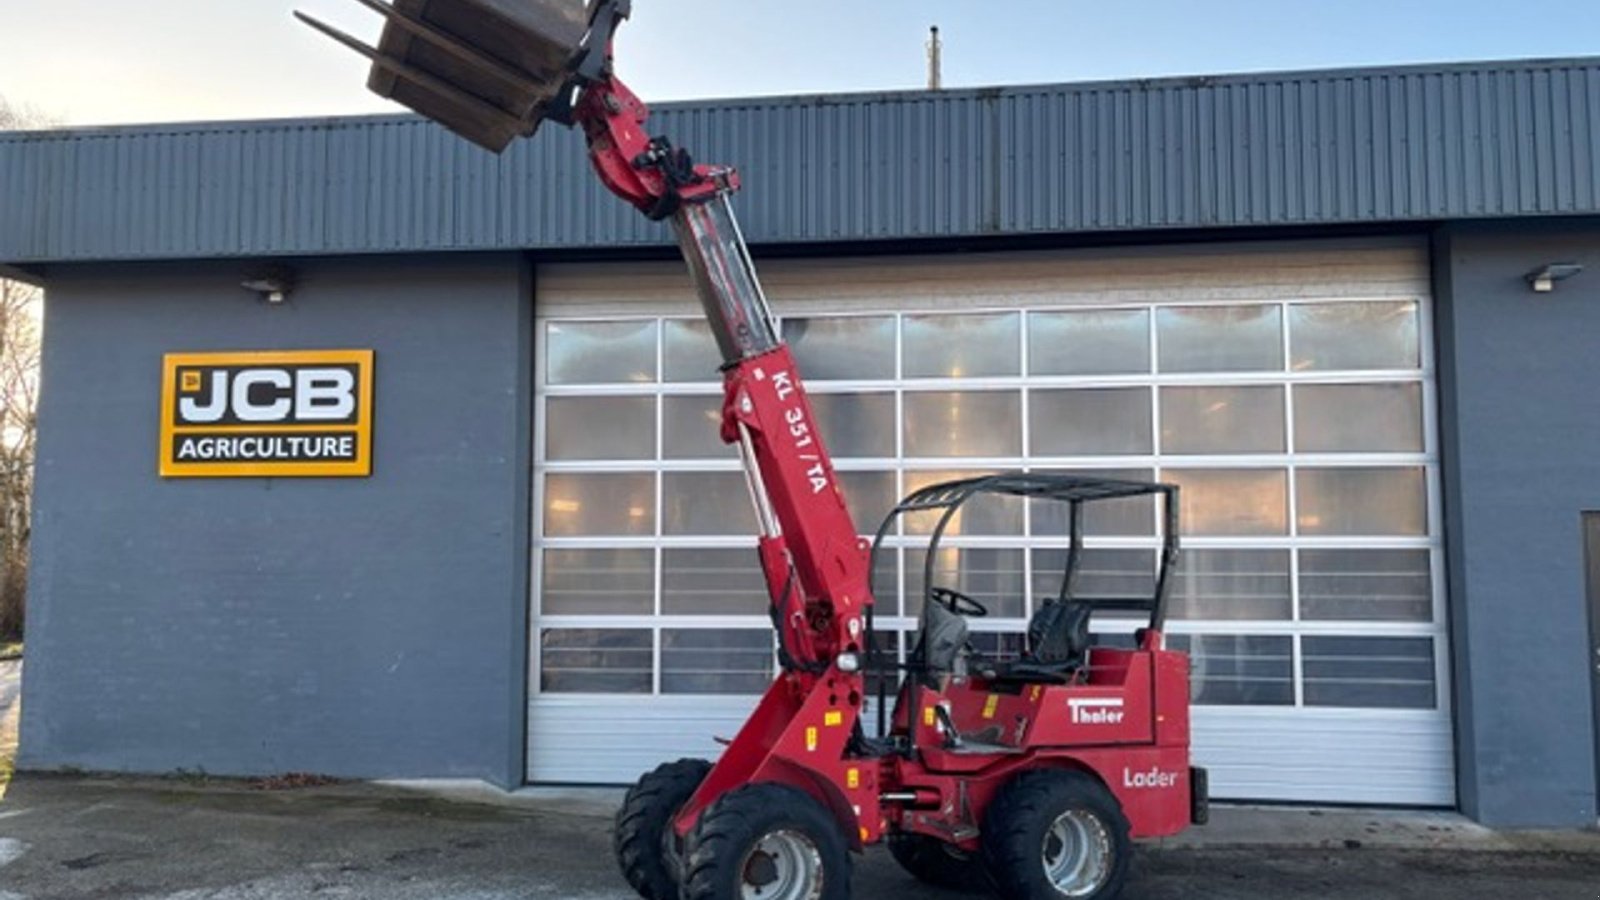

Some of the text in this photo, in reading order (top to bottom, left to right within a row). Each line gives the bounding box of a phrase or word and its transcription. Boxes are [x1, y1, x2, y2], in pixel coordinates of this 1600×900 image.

[179, 368, 355, 422] JCB
[772, 371, 793, 400] KL
[178, 437, 353, 459] AGRICULTURE
[1124, 766, 1177, 788] Lader
